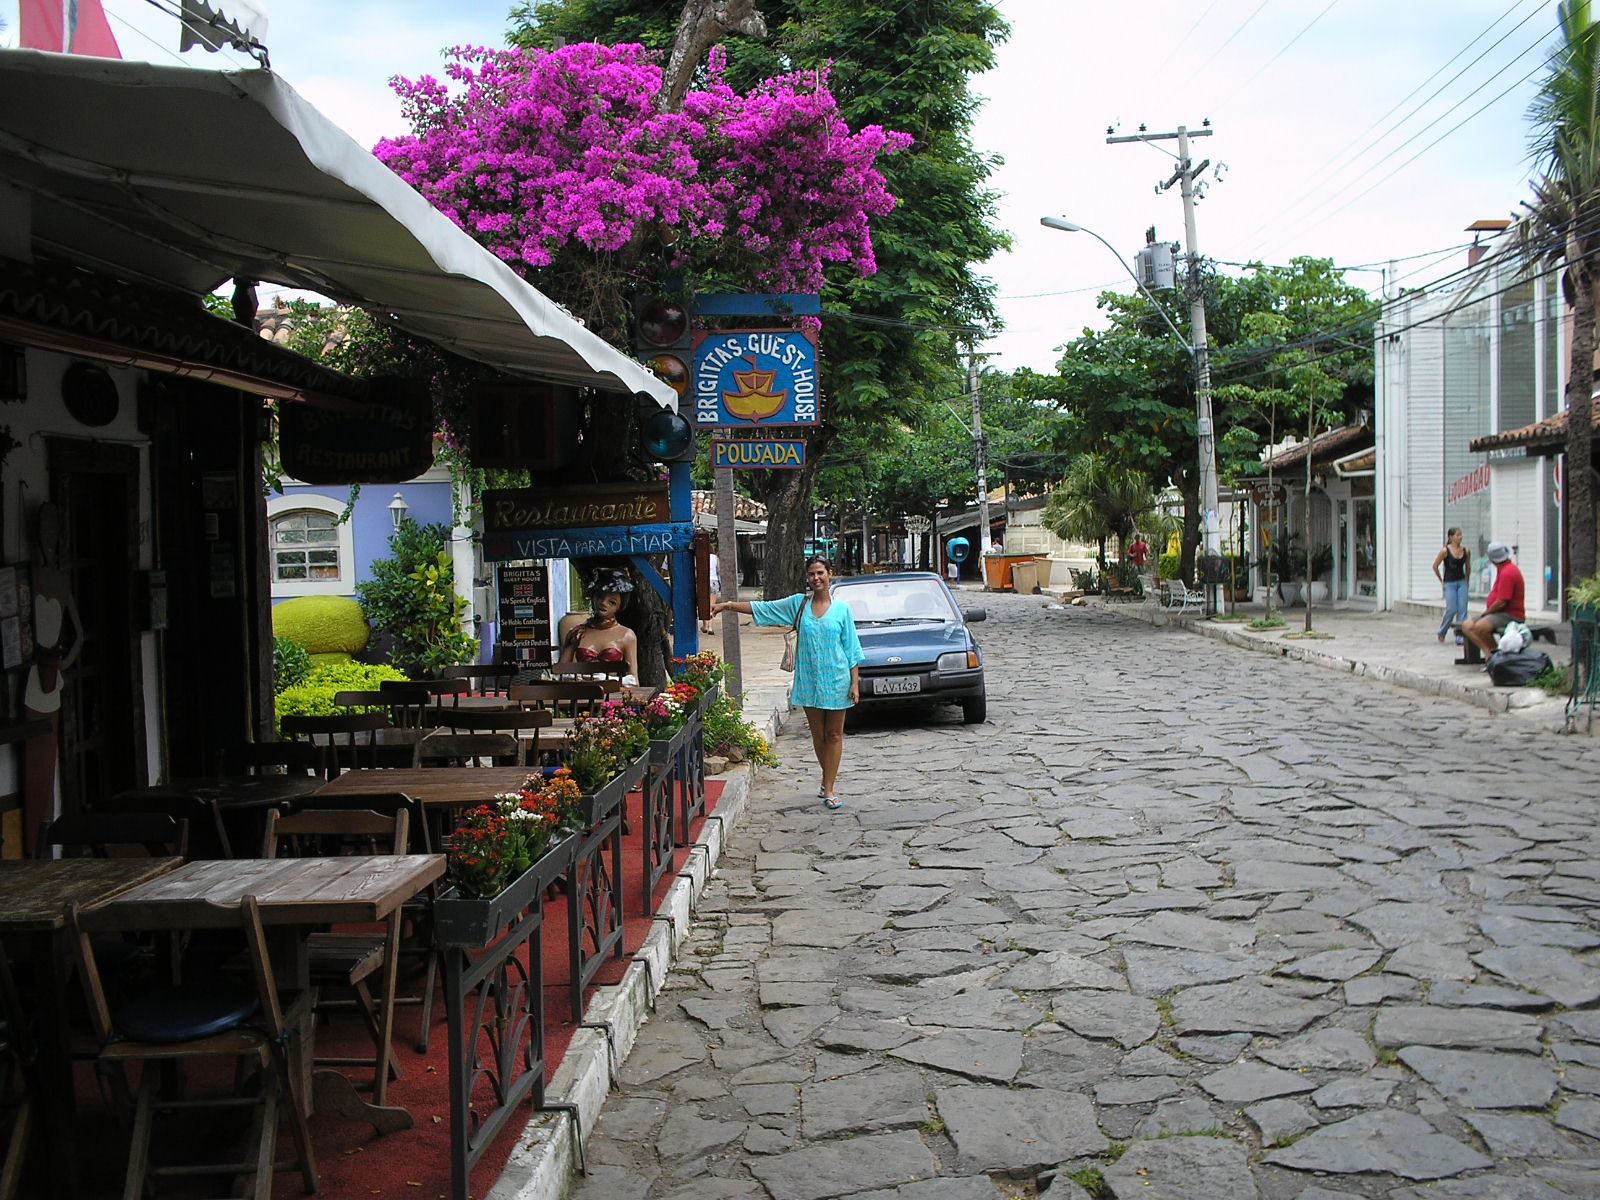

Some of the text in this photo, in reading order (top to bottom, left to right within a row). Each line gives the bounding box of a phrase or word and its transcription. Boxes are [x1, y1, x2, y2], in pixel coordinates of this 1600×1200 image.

[748, 333, 807, 371] GUEST
[792, 368, 816, 422] HOUSE
[716, 442, 801, 464] POUSADA
[494, 495, 657, 528] Restaurante
[516, 532, 676, 557] VISTA PARA O MAR
